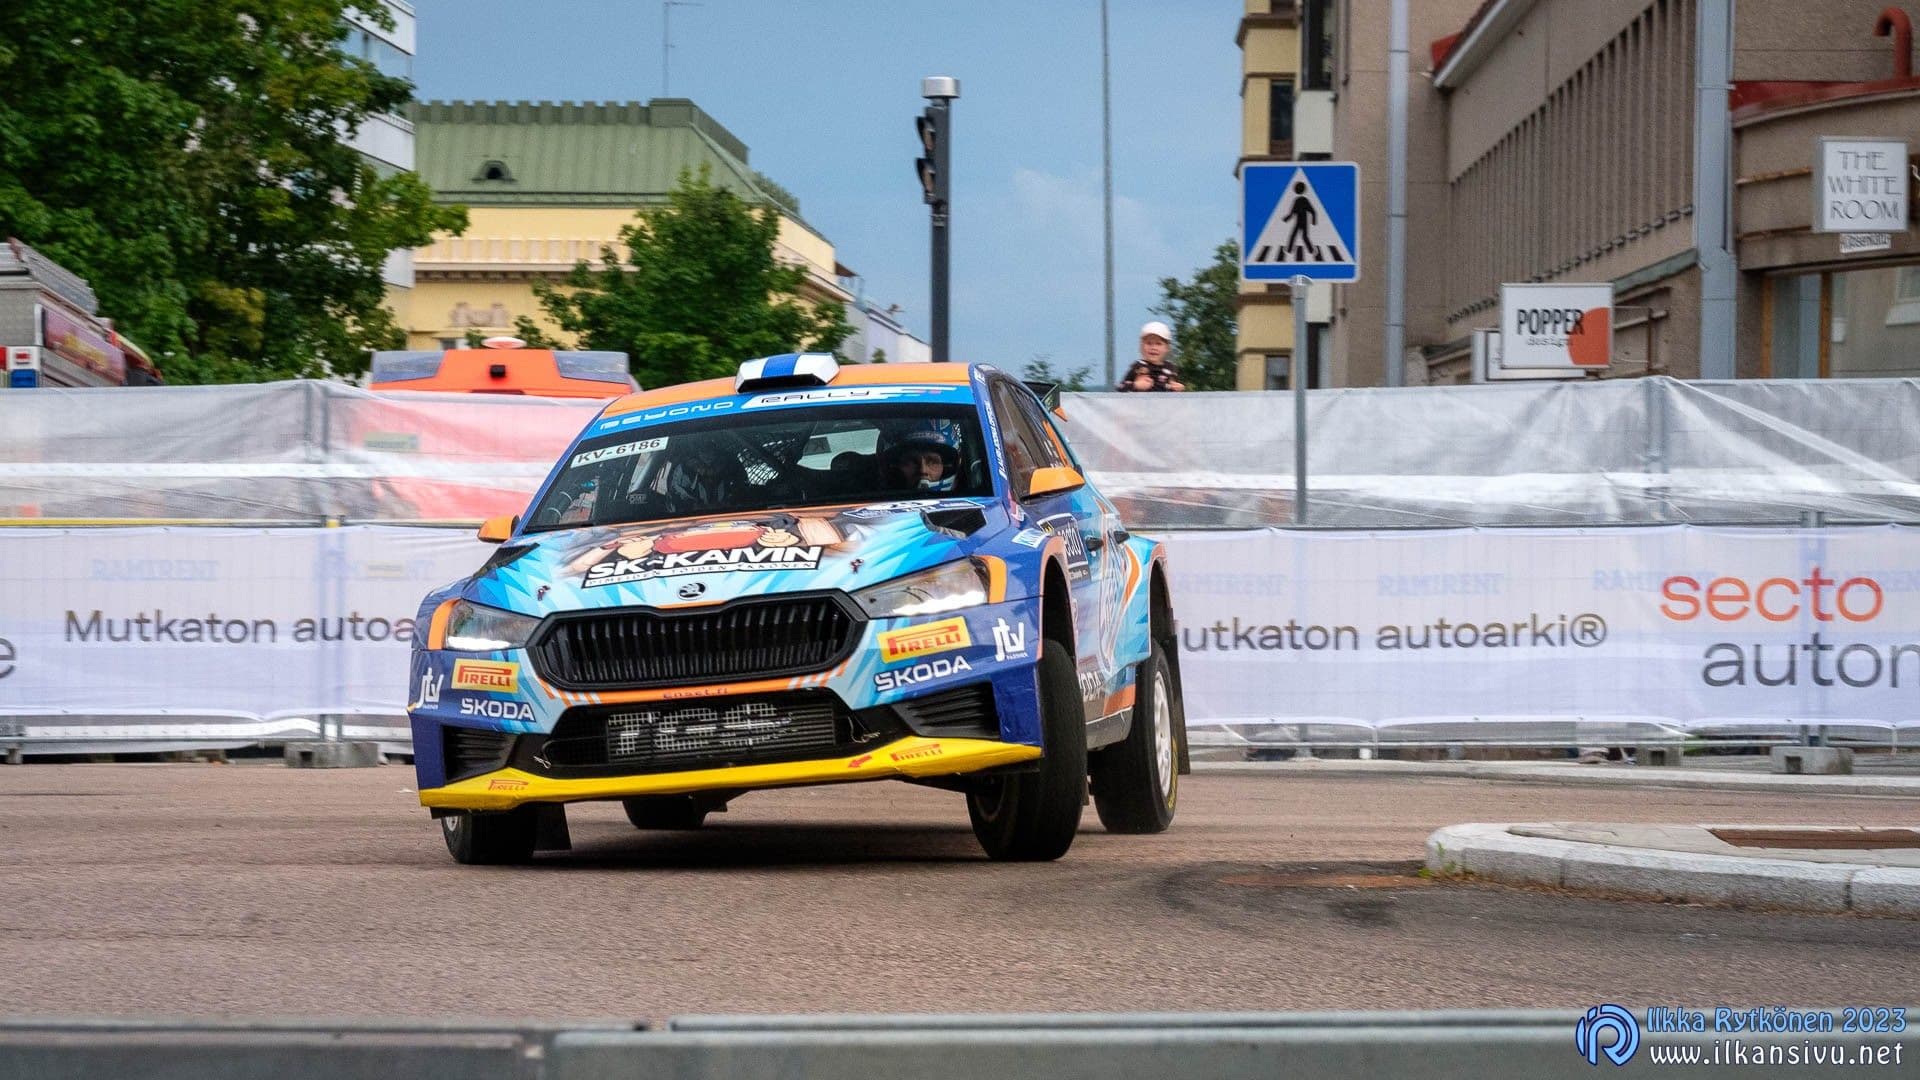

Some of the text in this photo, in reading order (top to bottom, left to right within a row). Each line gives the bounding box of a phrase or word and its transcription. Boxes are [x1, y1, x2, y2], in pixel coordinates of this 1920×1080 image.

[1837, 151, 1888, 170] THE
[1827, 175, 1902, 195] WHITE
[1831, 200, 1900, 220] ROOM
[1516, 308, 1585, 335] POPPER
[600, 389, 870, 430] BEYOND RALLY
[577, 439, 661, 463] KV-6186
[1659, 565, 1884, 622] secto
[64, 609, 278, 643] Mutkaton
[1172, 617, 1359, 652] utkaton
[886, 624, 961, 656] PIRELLI
[457, 664, 513, 687] PIRELLI
[890, 743, 943, 762] PIRELLI
[487, 778, 529, 792] PIRELLI
